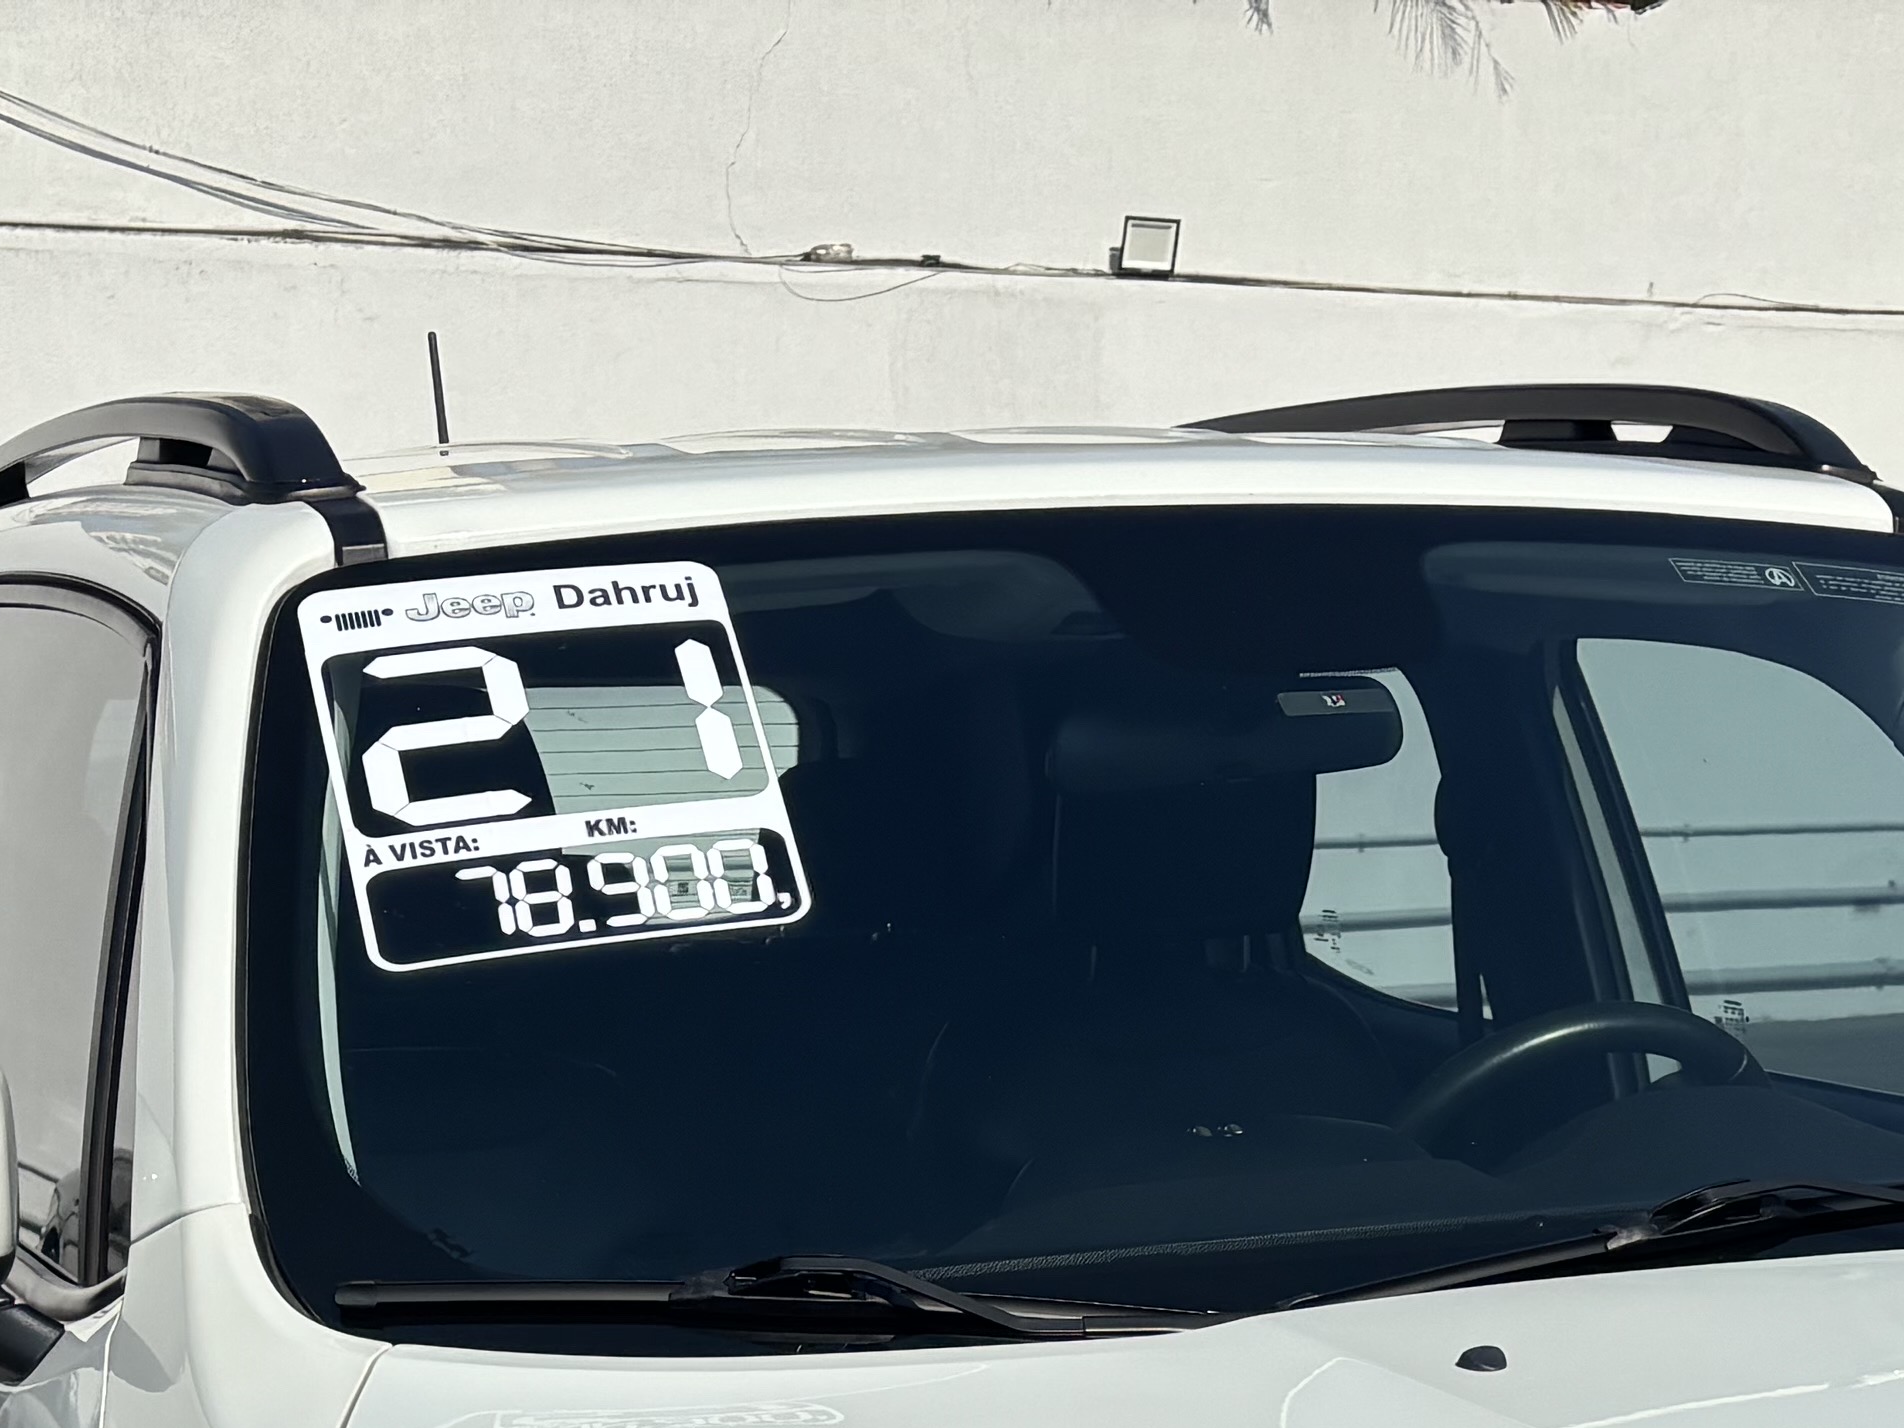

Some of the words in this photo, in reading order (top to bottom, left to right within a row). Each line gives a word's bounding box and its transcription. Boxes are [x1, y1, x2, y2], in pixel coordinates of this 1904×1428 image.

[405, 591, 534, 622] Jeep
[552, 576, 700, 610] Dahruj
[361, 638, 744, 827] 21
[363, 844, 383, 867] À
[388, 834, 481, 862] VISTA:
[584, 816, 638, 838] KM:
